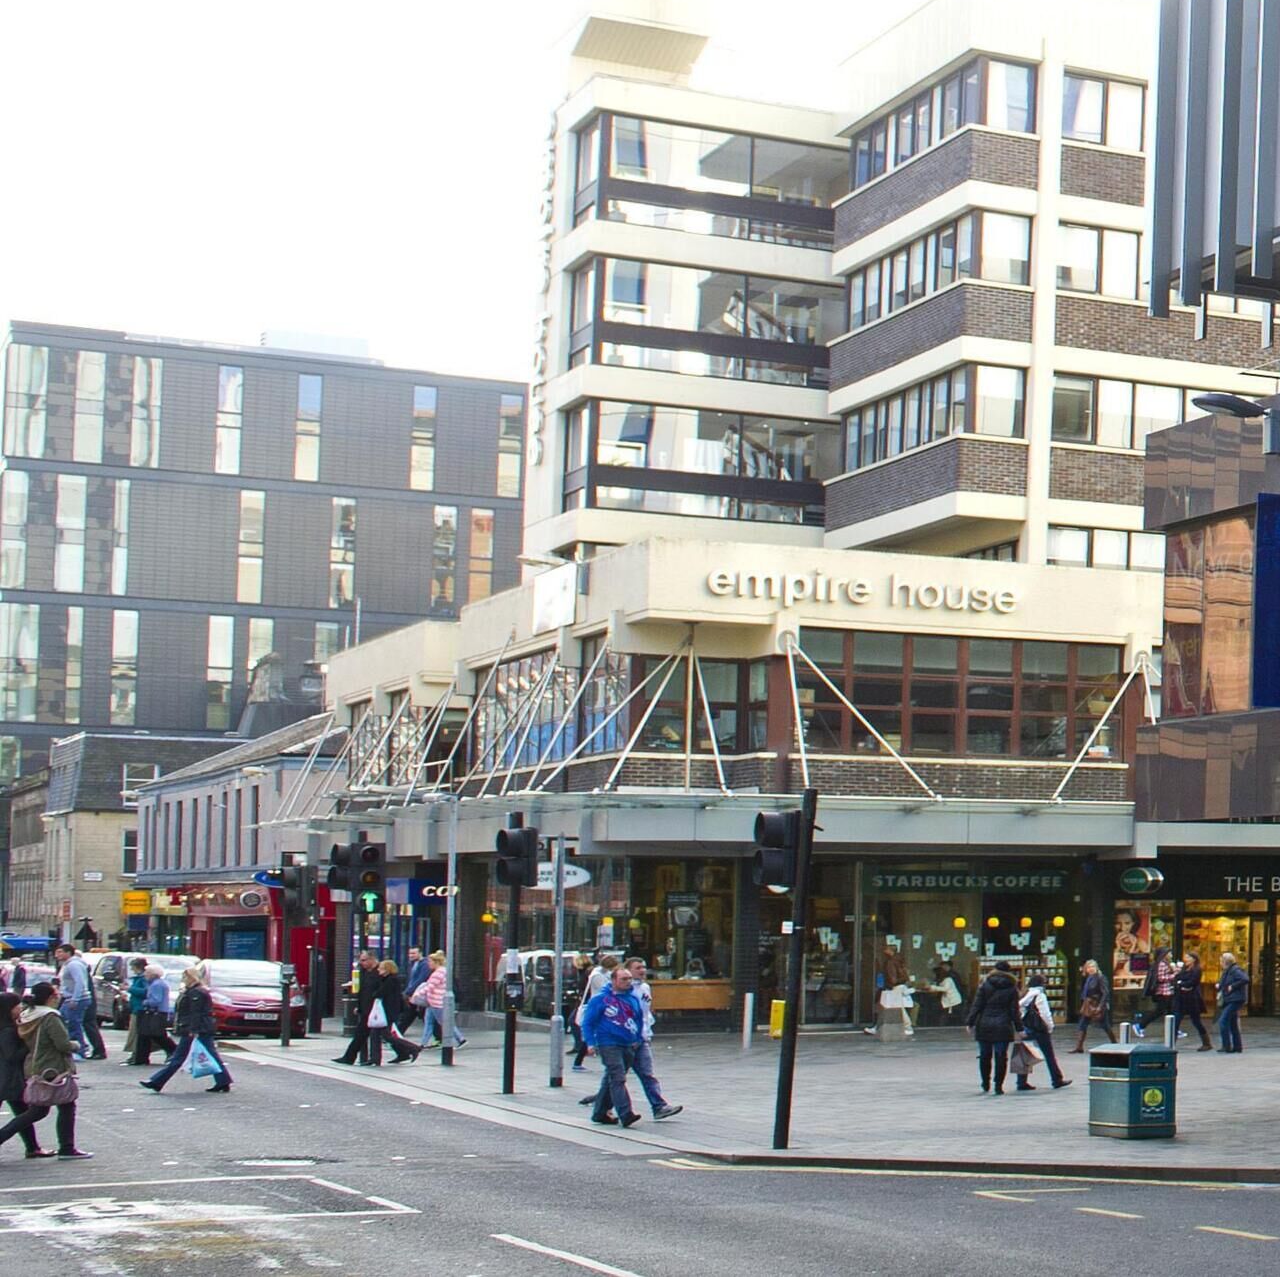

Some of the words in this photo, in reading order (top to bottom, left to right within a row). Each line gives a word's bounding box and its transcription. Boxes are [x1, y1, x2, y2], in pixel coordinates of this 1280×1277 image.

[707, 566, 874, 608] empire
[891, 570, 1021, 614] house
[871, 874, 988, 888] STARBUCKS
[992, 875, 1063, 888] COFFEE
[1224, 876, 1262, 892] THE
